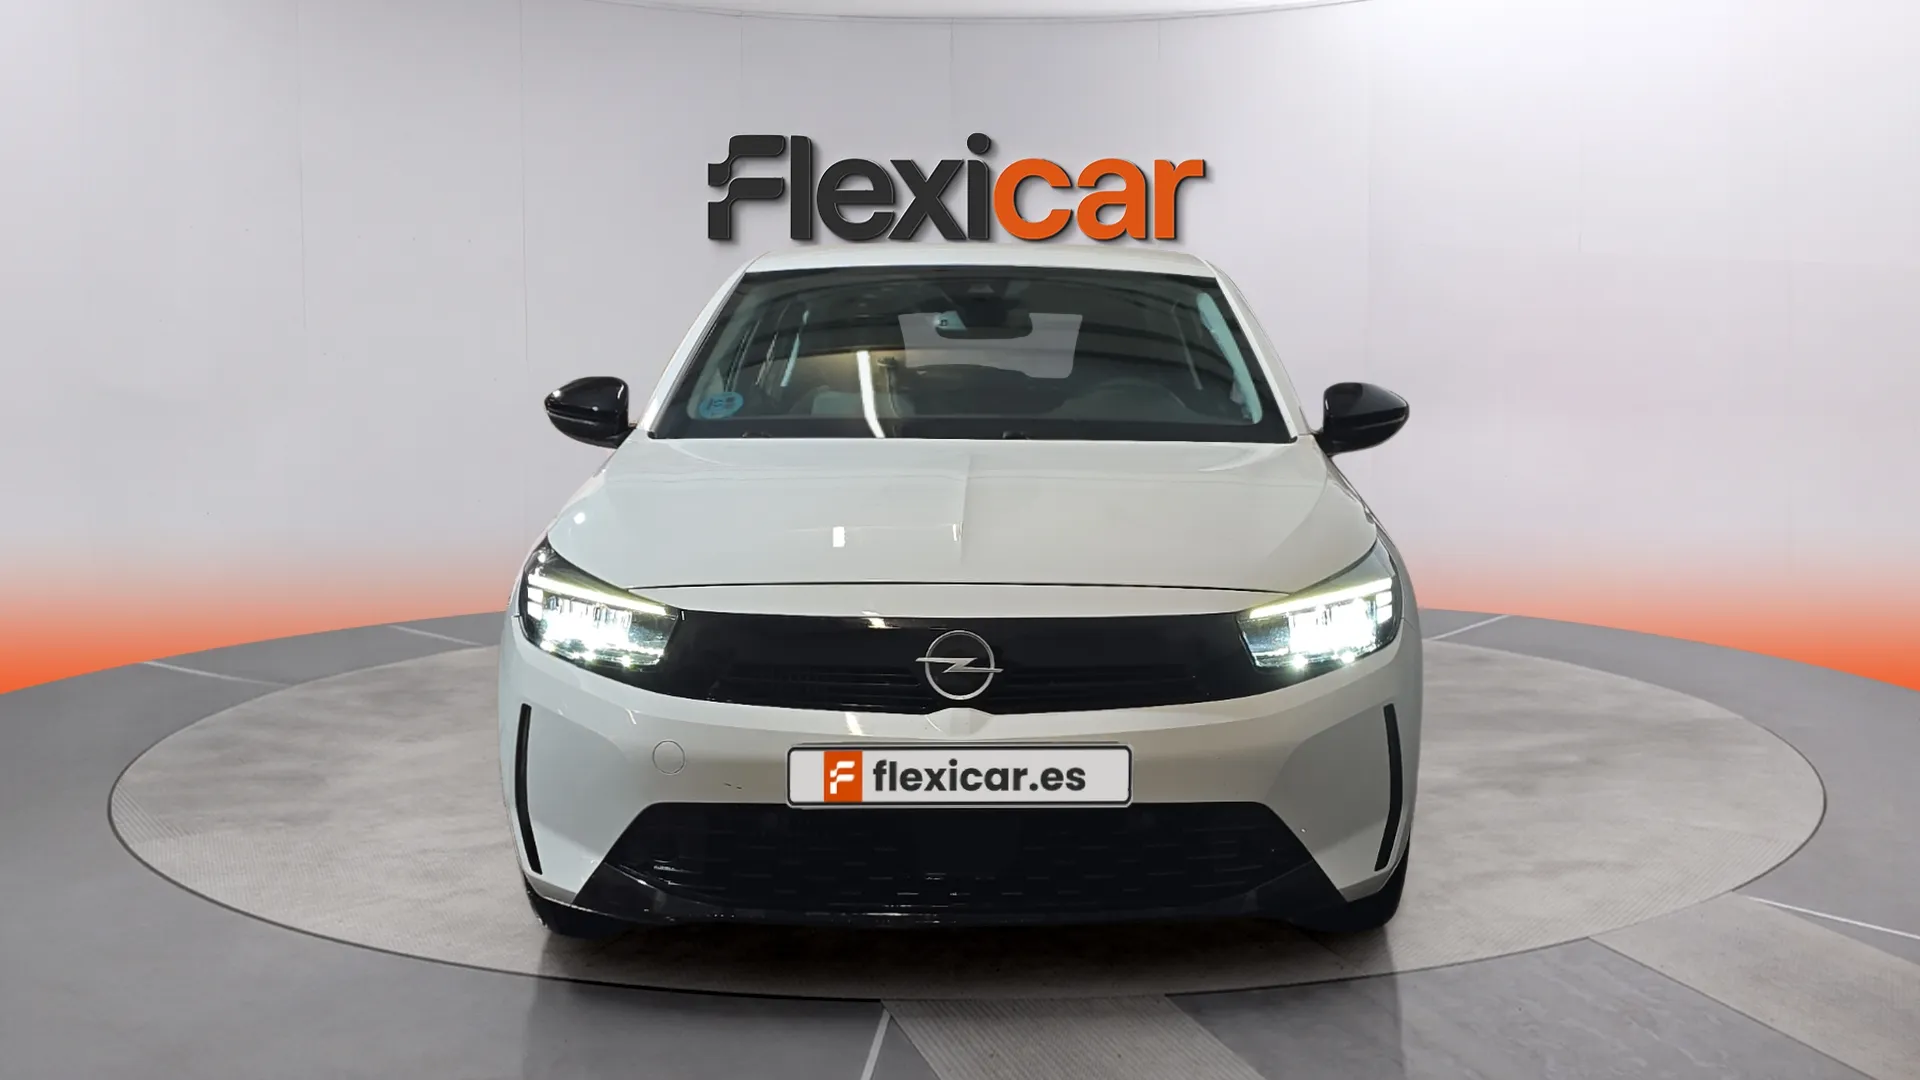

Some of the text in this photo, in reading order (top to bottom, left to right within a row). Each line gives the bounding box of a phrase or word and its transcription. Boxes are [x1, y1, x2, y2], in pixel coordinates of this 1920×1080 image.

[707, 132, 1206, 241] Flexicar
[829, 760, 855, 794] F
[872, 758, 1086, 792] flexicar.es
